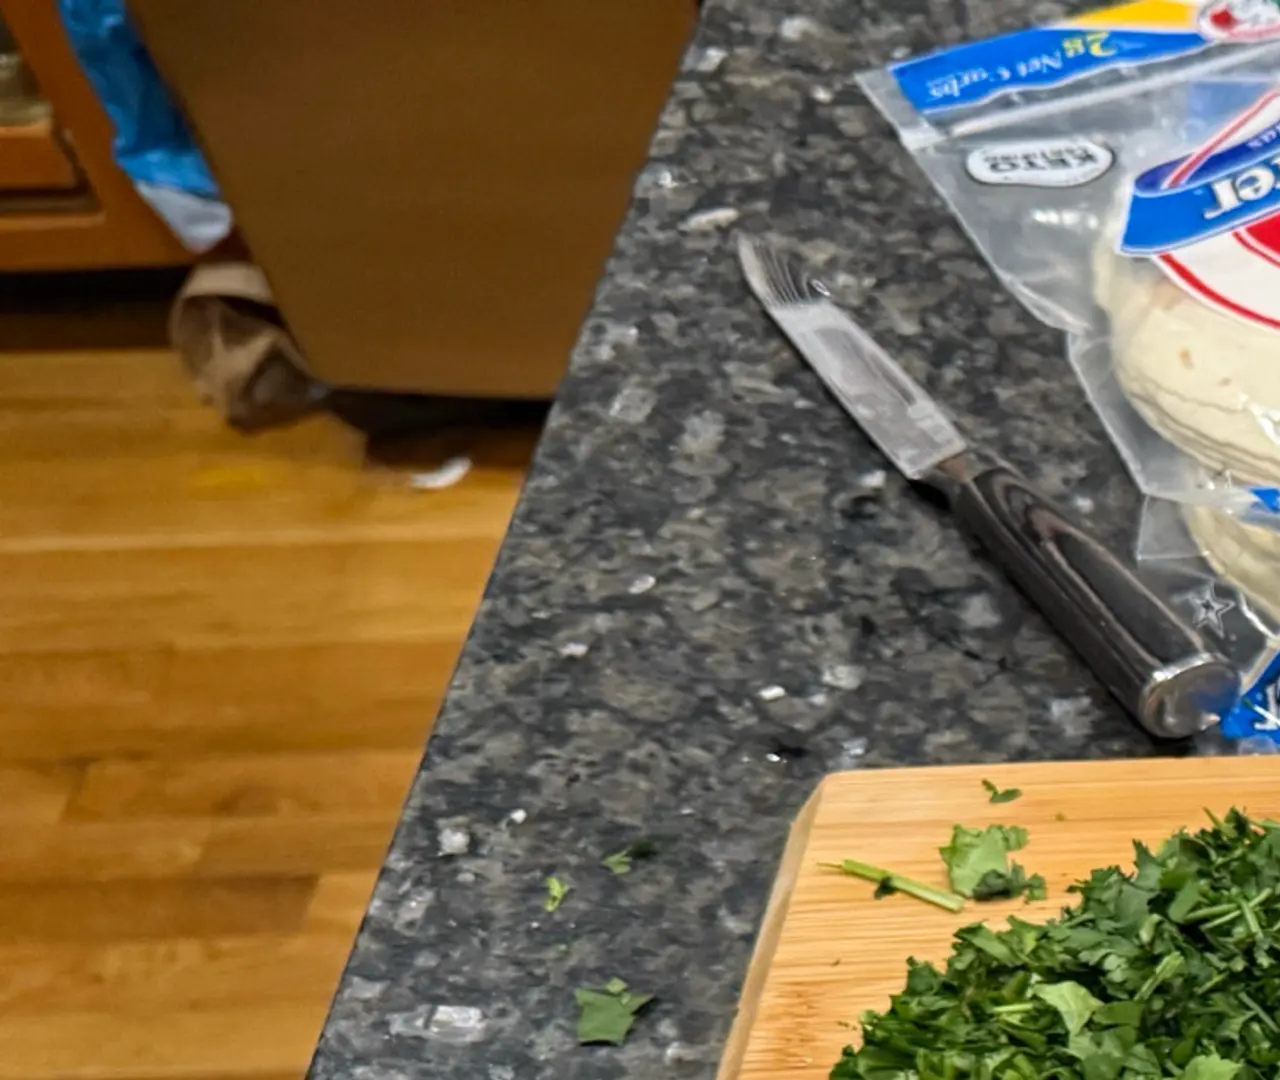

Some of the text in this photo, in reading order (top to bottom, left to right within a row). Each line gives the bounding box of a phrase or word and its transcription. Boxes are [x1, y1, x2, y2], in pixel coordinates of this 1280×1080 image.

[927, 31, 1117, 98] 2g Net Carbs
[989, 147, 1098, 172] KETO
